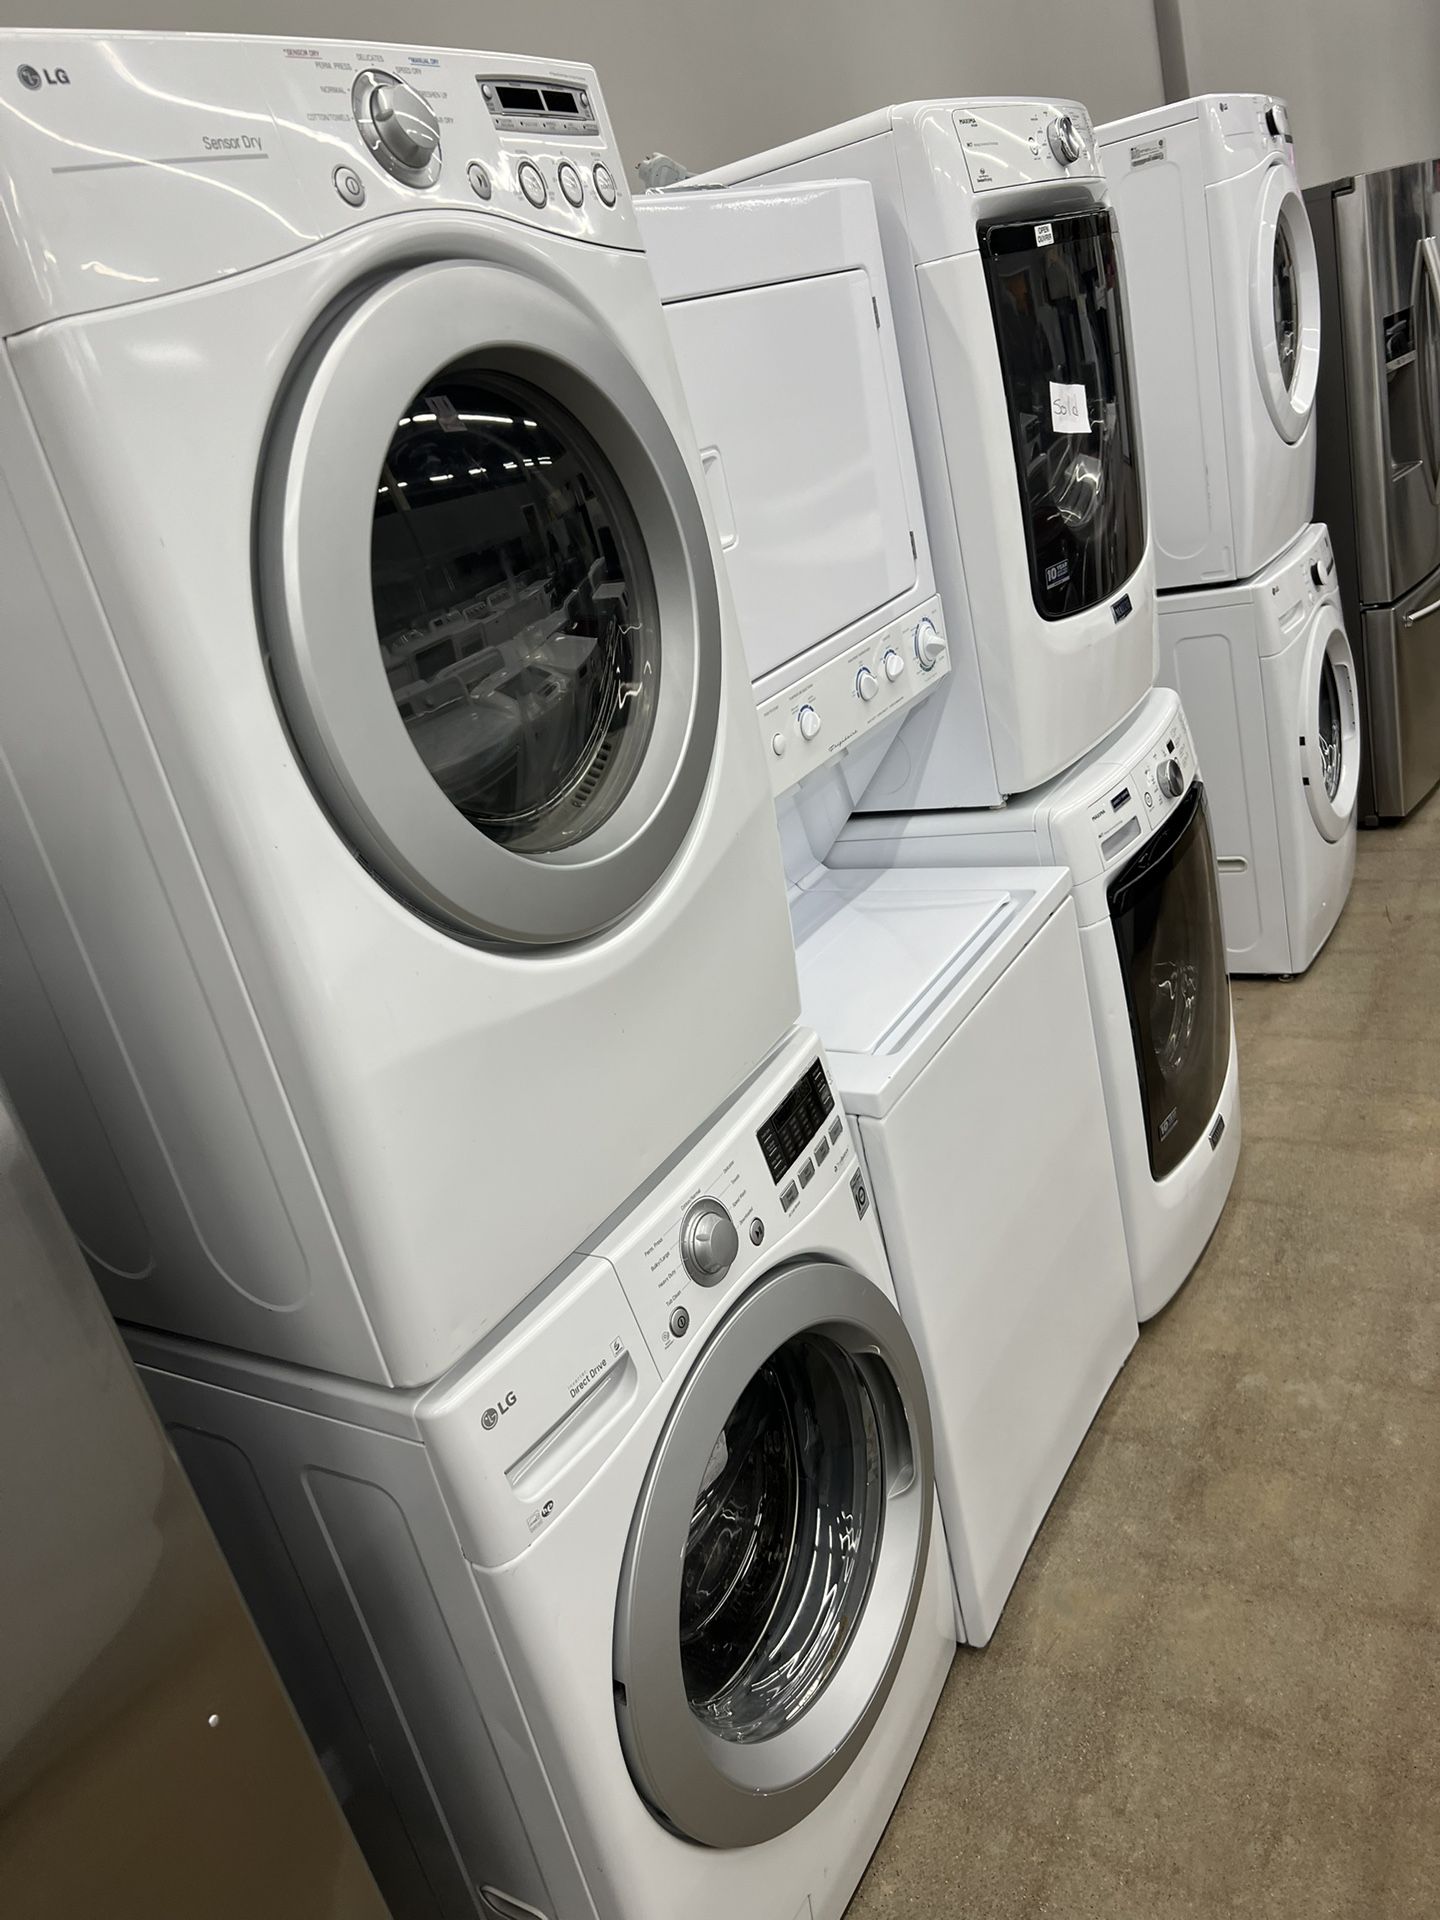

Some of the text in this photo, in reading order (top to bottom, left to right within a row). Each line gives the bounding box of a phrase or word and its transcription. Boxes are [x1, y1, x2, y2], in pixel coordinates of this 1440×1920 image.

[42, 69, 70, 85] LG
[202, 135, 262, 151] Sensor Dry
[1038, 226, 1050, 234] OPEN
[1053, 398, 1079, 417] Sold
[1047, 567, 1057, 582] 10
[828, 730, 858, 752] Frigidaire
[569, 1359, 607, 1398] Direct Drive
[497, 1391, 517, 1415] LG
